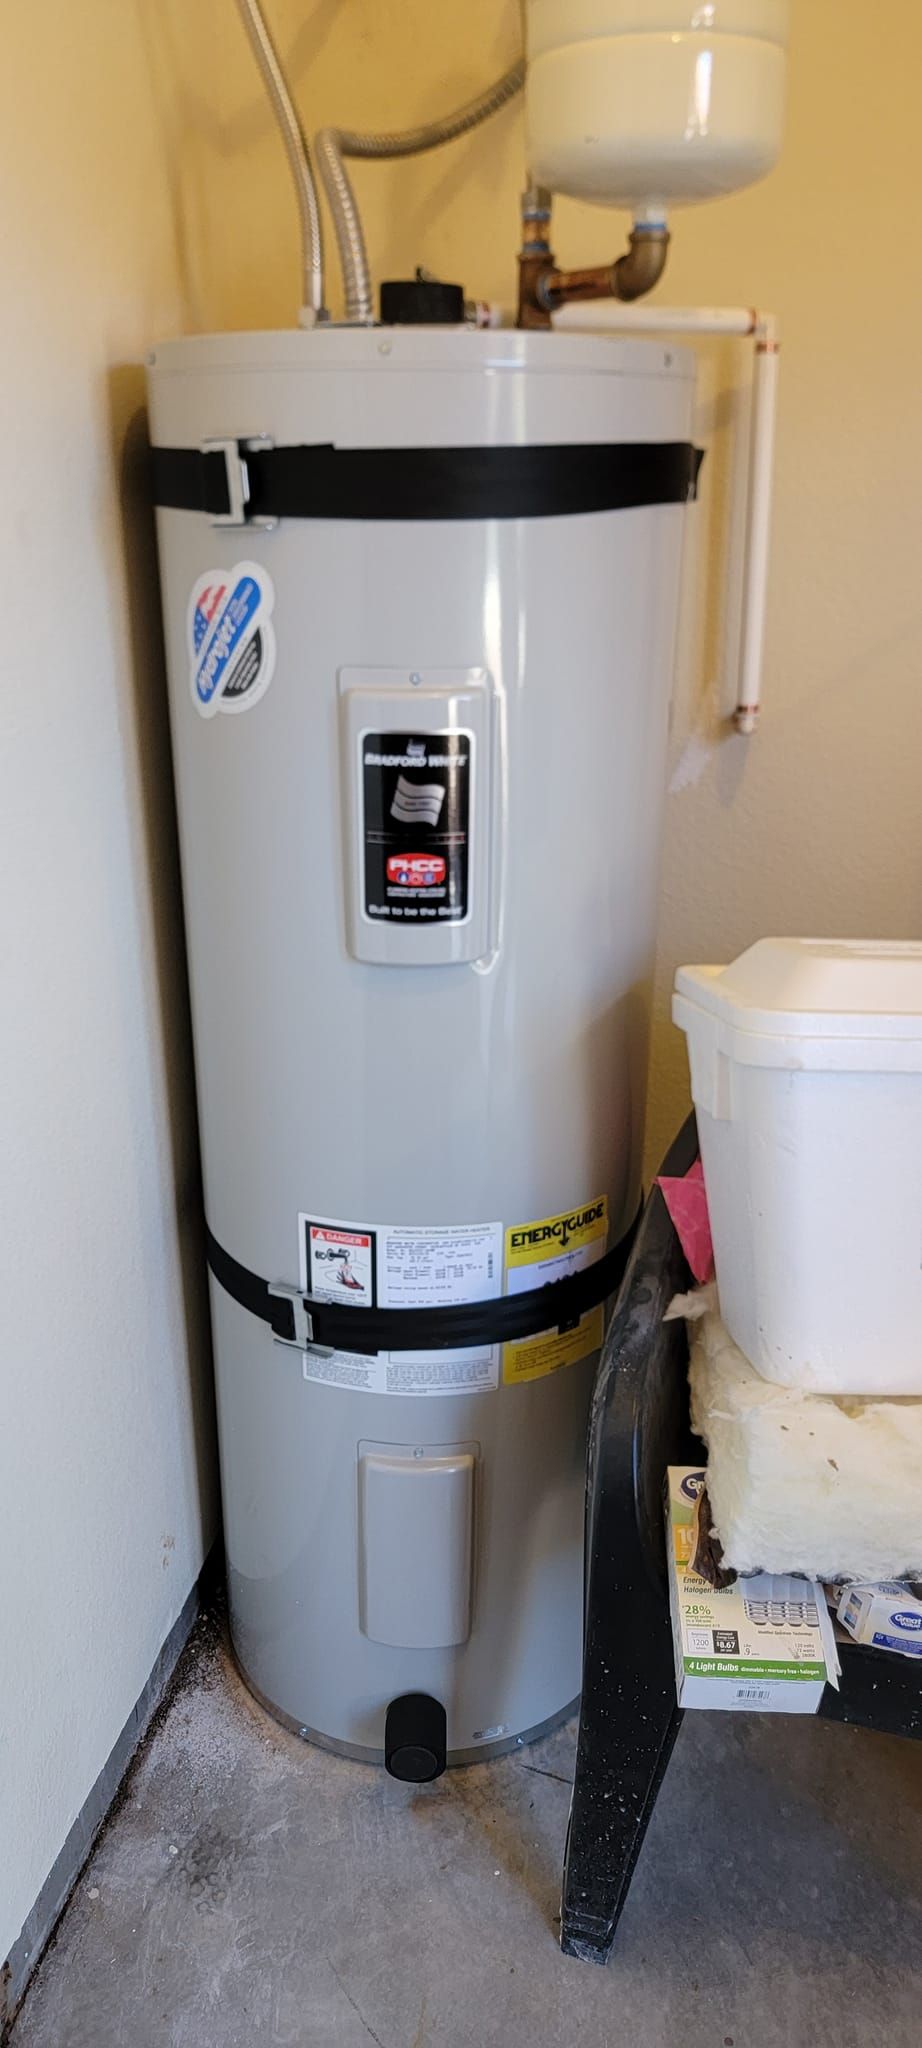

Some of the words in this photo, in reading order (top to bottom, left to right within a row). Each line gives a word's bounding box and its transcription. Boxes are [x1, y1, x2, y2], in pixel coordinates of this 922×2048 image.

[364, 752, 427, 767] BRADFORD
[427, 754, 468, 767] WHITE
[389, 859, 443, 871] PHCC
[368, 904, 390, 914] Built
[391, 906, 403, 915] to
[403, 907, 418, 916] be
[419, 907, 437, 916] the
[437, 906, 463, 915] Best
[326, 1232, 362, 1246] DANGER
[683, 1576, 706, 1585] Energy
[684, 1586, 712, 1595] Halogen
[894, 1613, 922, 1625] Great
[692, 1639, 710, 1647] 1200
[688, 1661, 695, 1669] 4
[696, 1661, 716, 1672] Light
[717, 1662, 739, 1672] Bulbs
[767, 1667, 787, 1675] mercury
[799, 1668, 820, 1676] halogen
